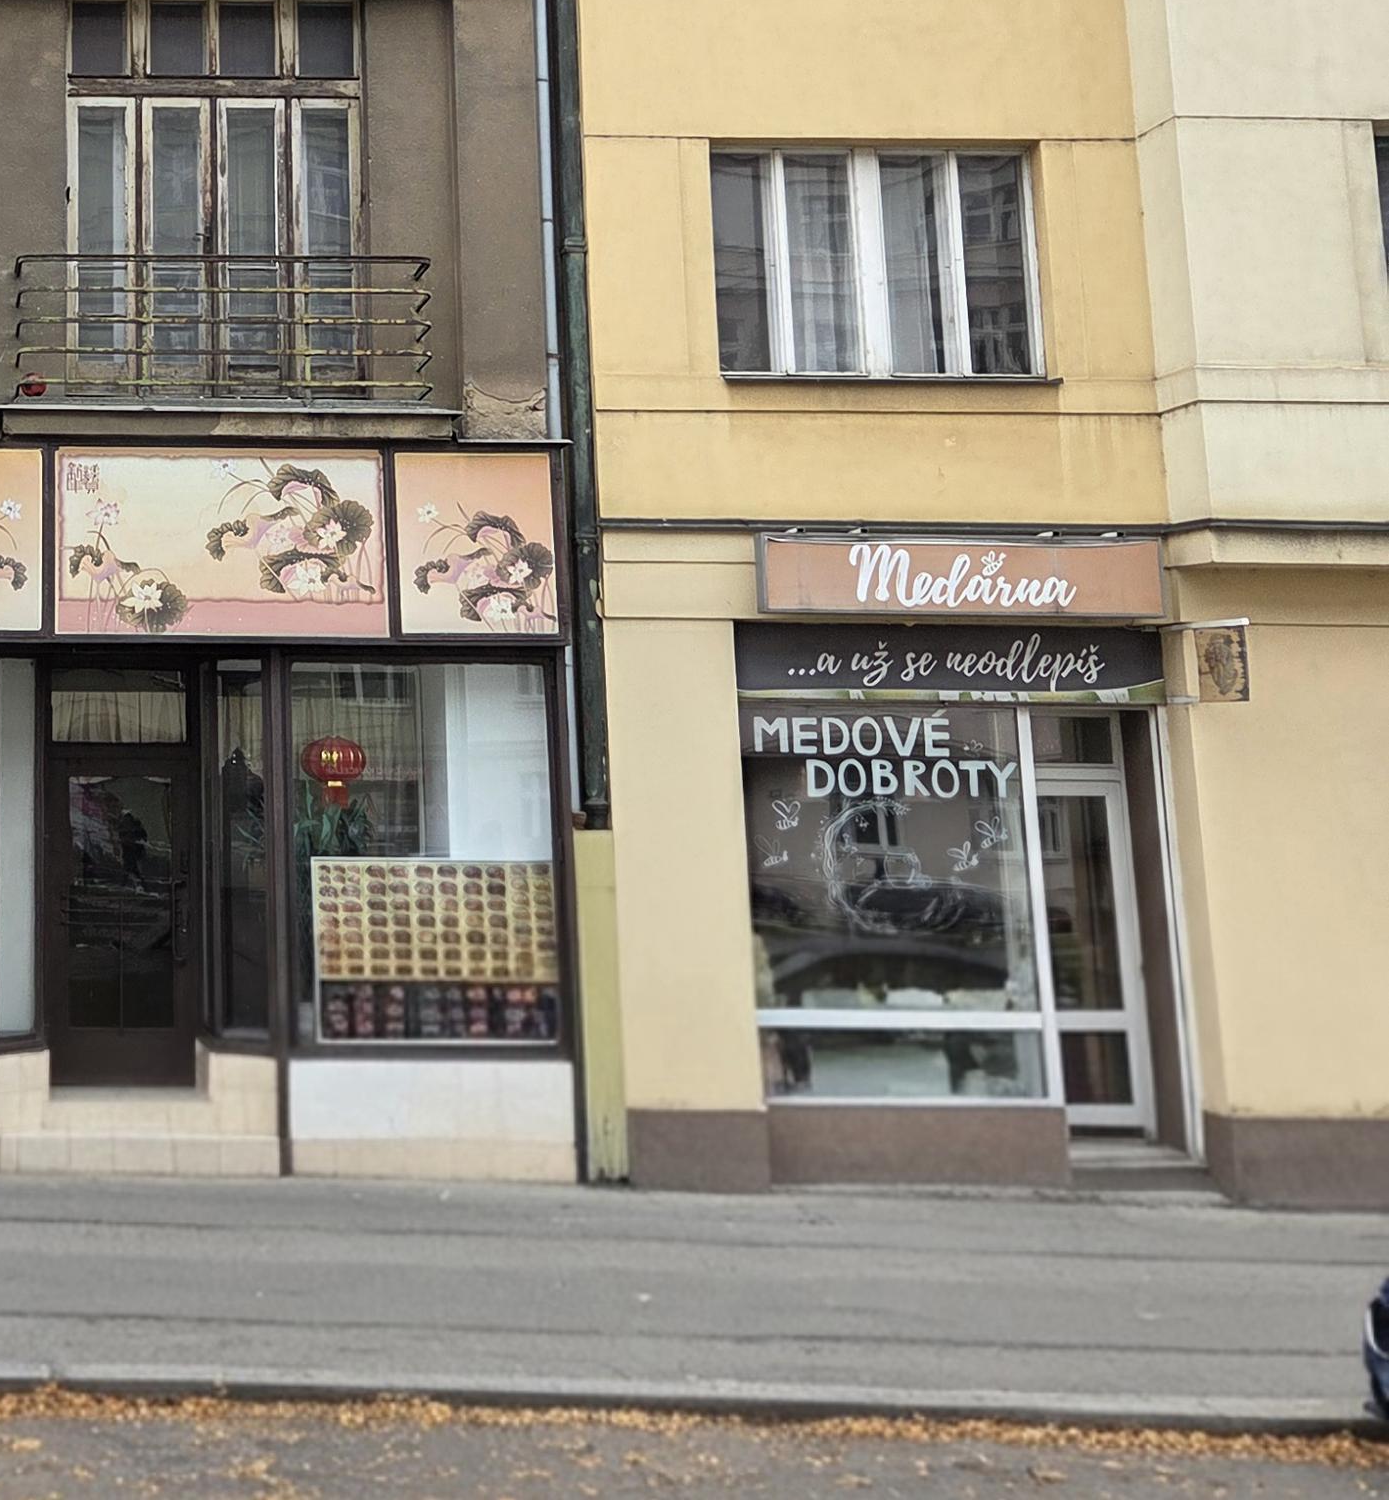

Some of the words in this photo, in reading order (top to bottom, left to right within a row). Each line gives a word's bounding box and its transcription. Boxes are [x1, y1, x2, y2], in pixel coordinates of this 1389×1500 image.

[849, 544, 1077, 608] Medárna
[851, 641, 893, 686] už
[902, 650, 936, 678] se
[947, 634, 1106, 692] neodlepíš
[753, 710, 950, 758] MEDOVÉ
[806, 758, 1018, 799] DOBROTY
